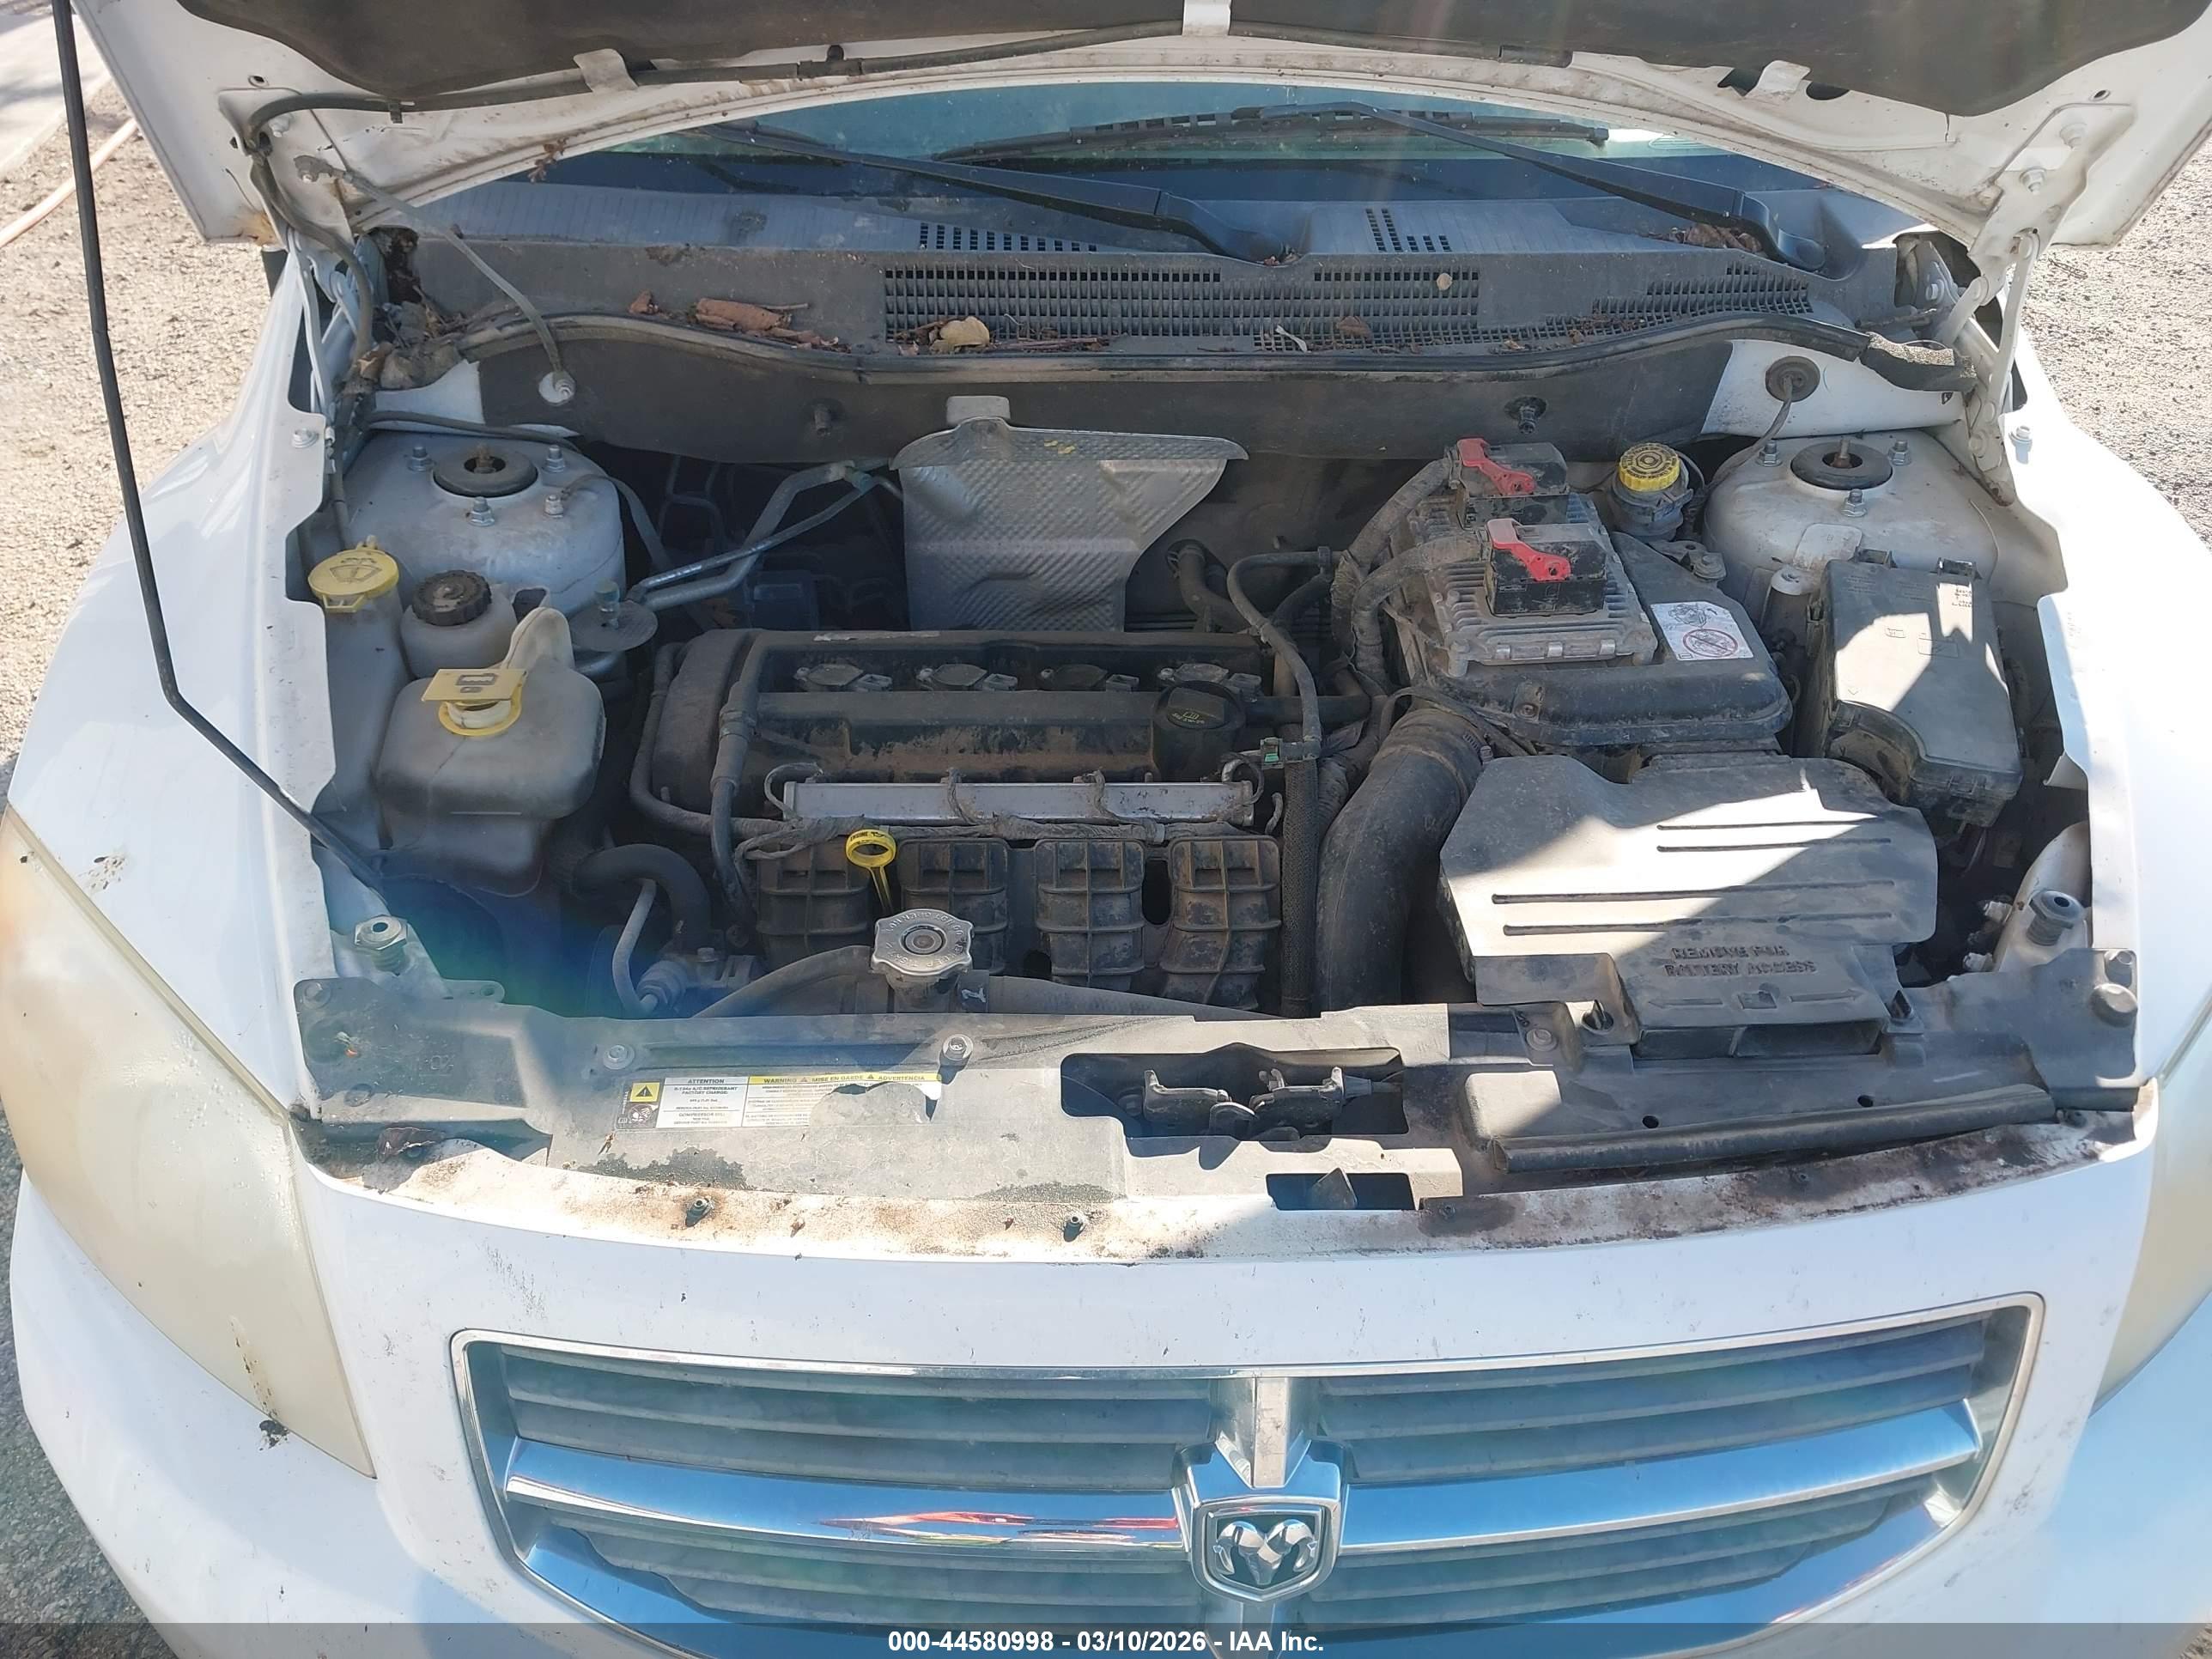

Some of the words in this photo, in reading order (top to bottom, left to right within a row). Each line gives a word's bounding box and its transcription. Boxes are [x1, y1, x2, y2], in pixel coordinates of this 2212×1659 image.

[1671, 946, 1750, 959] REMOVE
[1752, 945, 1790, 957] FOR
[1663, 962, 1740, 976] BATTERY
[1747, 960, 1818, 975] ACCESS
